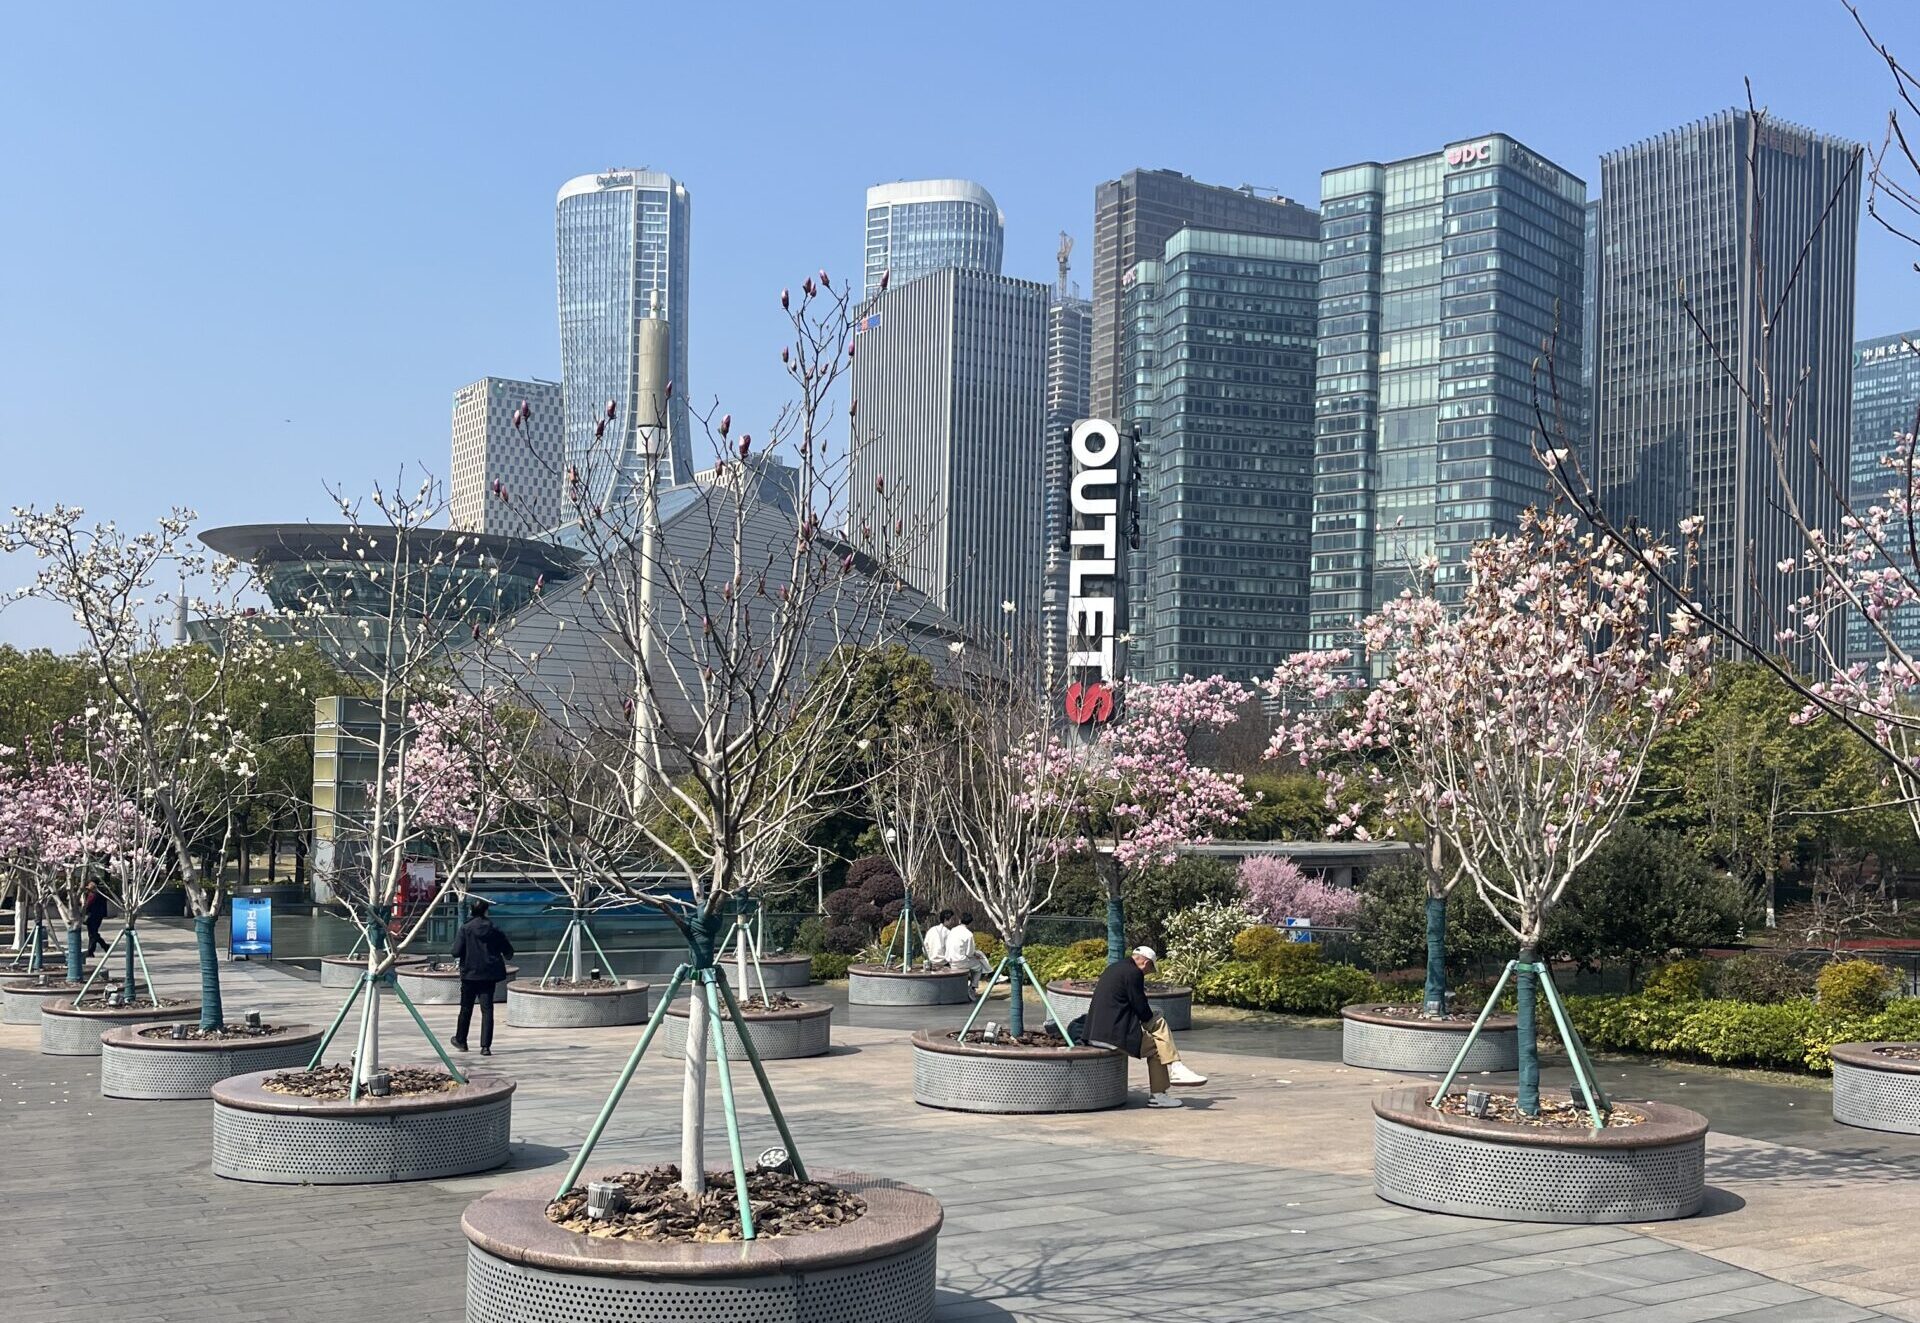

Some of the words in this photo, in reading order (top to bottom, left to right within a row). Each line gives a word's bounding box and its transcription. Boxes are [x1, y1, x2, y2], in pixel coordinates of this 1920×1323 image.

[1066, 418, 1119, 724] OUTLETS
[246, 910, 257, 941] 卫生间
